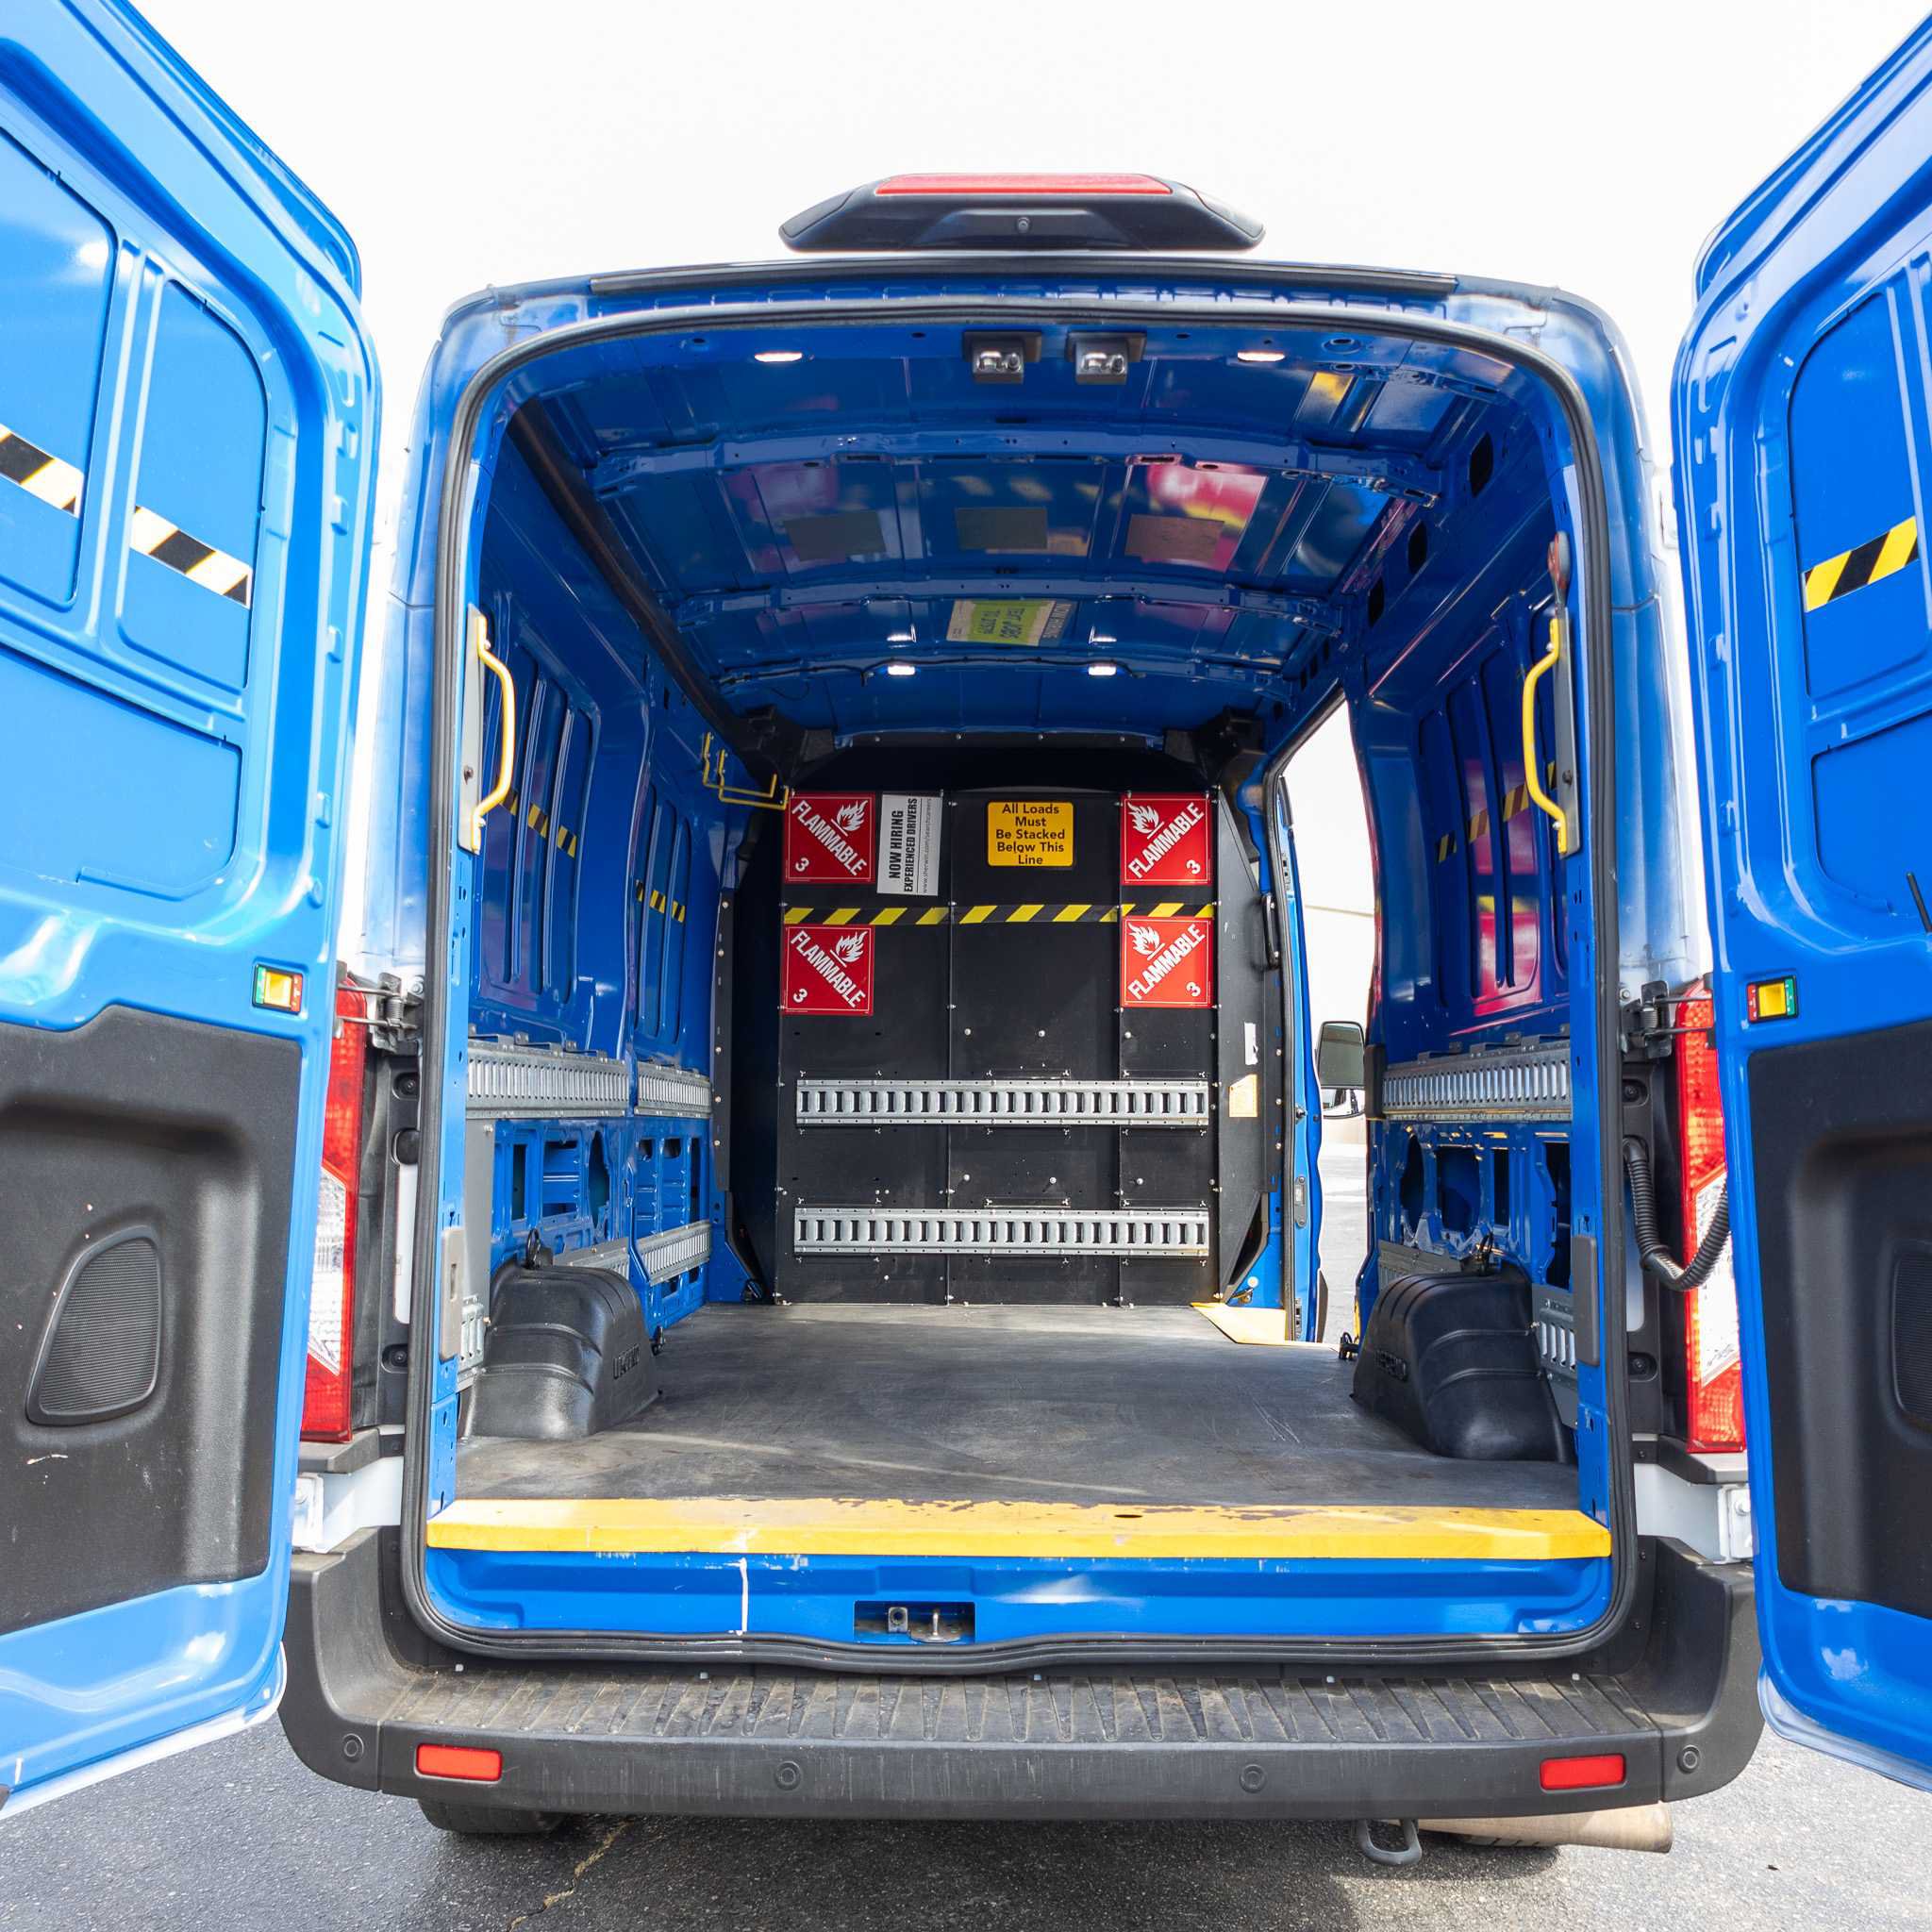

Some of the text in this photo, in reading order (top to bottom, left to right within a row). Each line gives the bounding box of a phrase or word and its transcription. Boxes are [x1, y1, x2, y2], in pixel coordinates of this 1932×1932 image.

[1002, 803, 1059, 814] All Loads
[1015, 816, 1046, 826] Must
[791, 800, 867, 876] FLAMMABLE
[996, 828, 1065, 839] Be Stacked
[1127, 802, 1205, 879] FLAMMABLE
[889, 810, 904, 879] NOW HIRING
[904, 798, 918, 892] EXPERIENCED DRIVERS
[997, 841, 1064, 853] Below This
[795, 857, 809, 872] 3
[1018, 855, 1043, 865] Line
[1186, 859, 1201, 874] 3
[791, 930, 866, 1008] FLAMMABLE
[1127, 924, 1206, 1000] FLAMMABLE
[792, 988, 808, 1003] 3
[1186, 981, 1201, 997] 3
